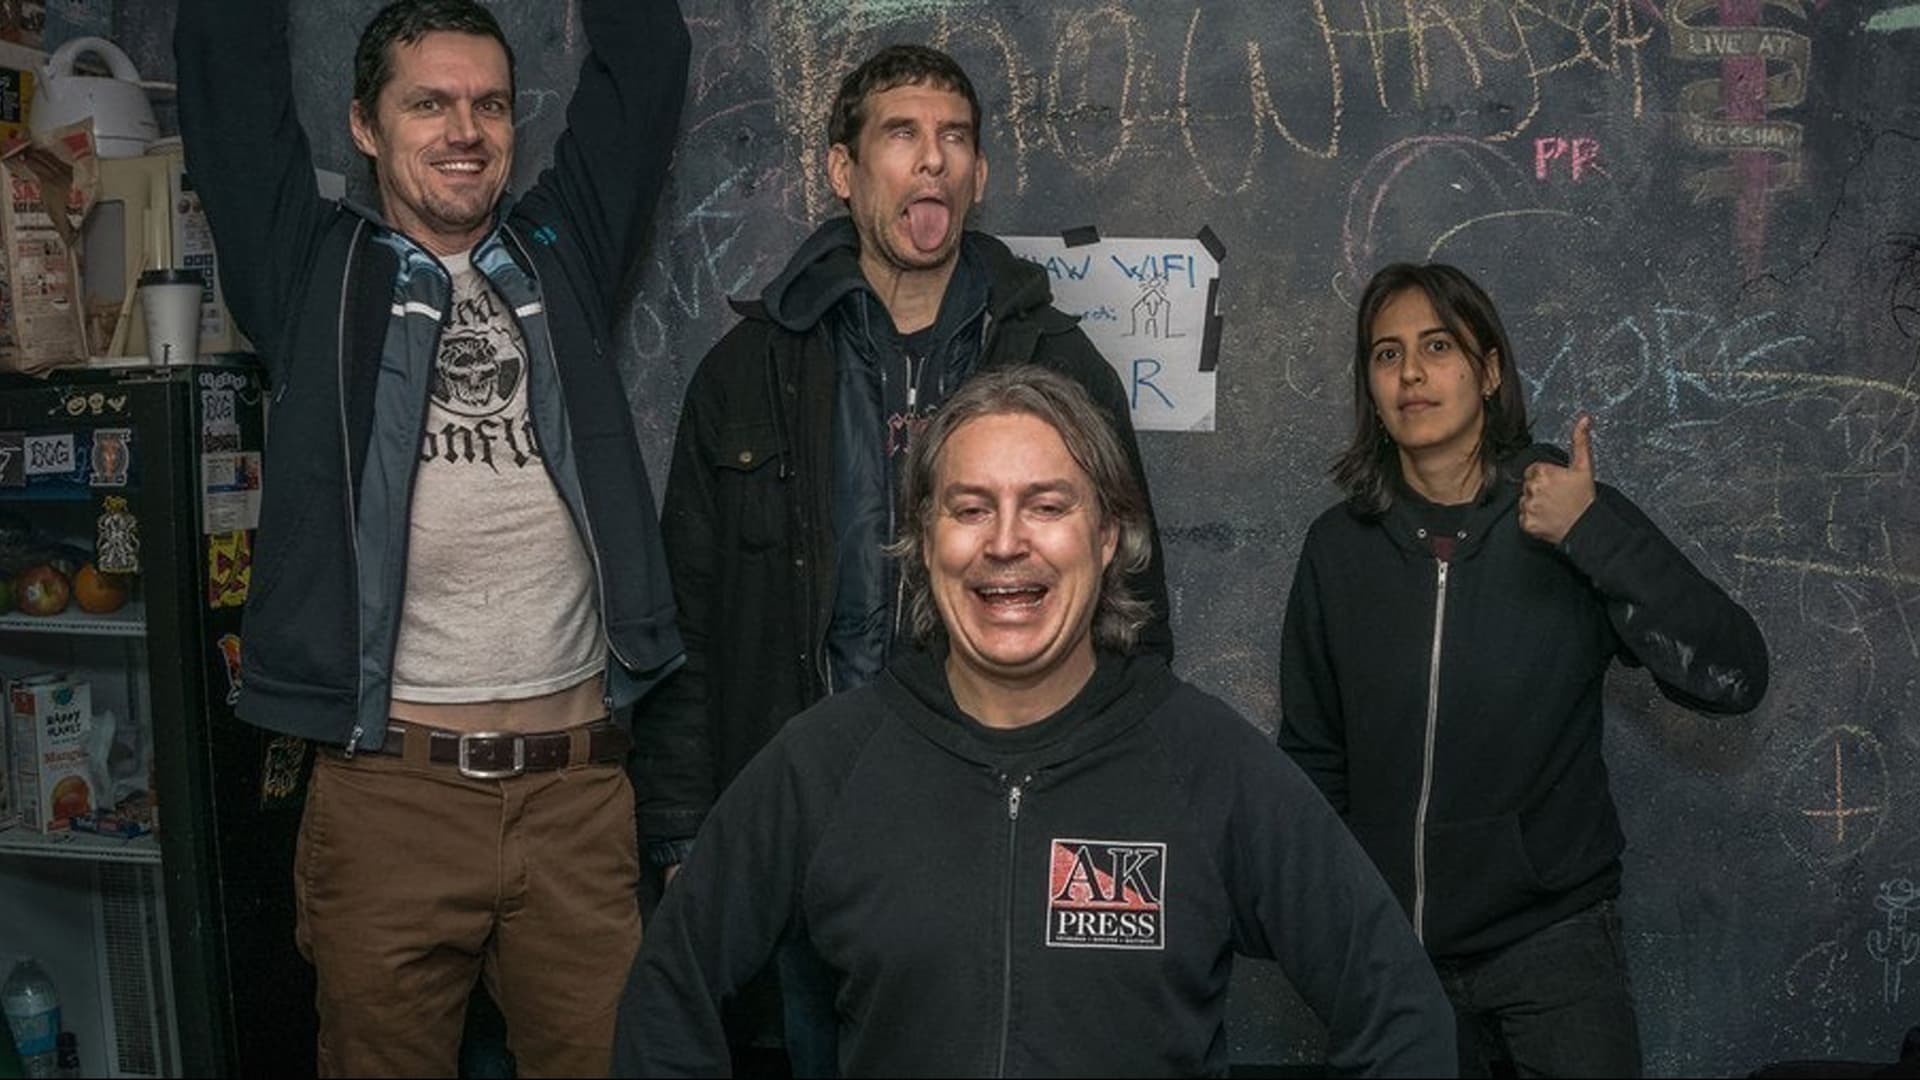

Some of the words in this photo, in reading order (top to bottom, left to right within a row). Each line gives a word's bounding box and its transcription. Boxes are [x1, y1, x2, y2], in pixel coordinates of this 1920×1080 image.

[1689, 32, 1742, 55] LIVE
[1759, 33, 1791, 56] AT
[1111, 253, 1195, 289] WIFI
[1052, 845, 1161, 904] AK
[1058, 911, 1155, 938] PRESS
